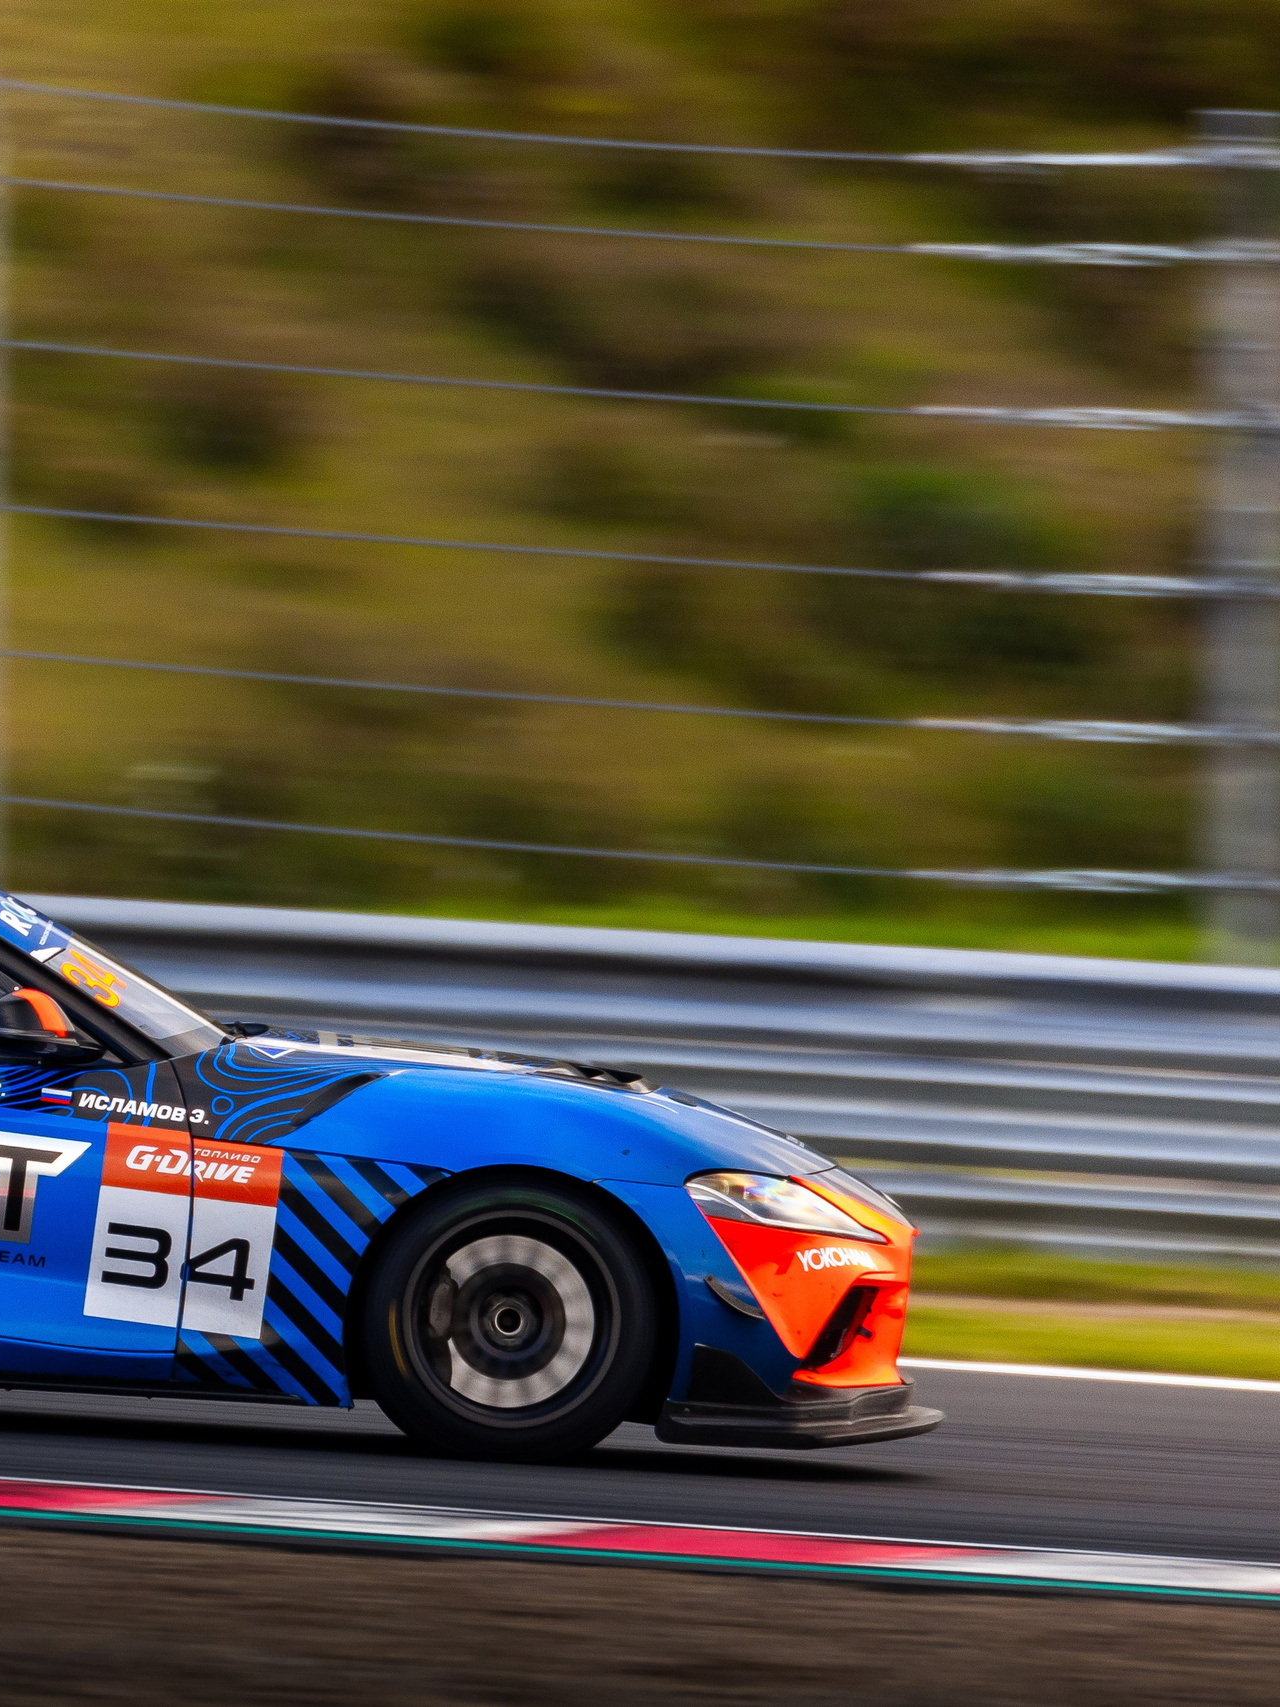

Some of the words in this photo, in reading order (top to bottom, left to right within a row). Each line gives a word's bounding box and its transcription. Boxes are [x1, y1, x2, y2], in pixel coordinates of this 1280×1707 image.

[60, 950, 127, 1009] 34
[78, 1093, 187, 1122] ИСЛАМОВ
[189, 1109, 210, 1125] Э.
[194, 1147, 262, 1164] ТОПЛИВО
[101, 1222, 256, 1302] 34
